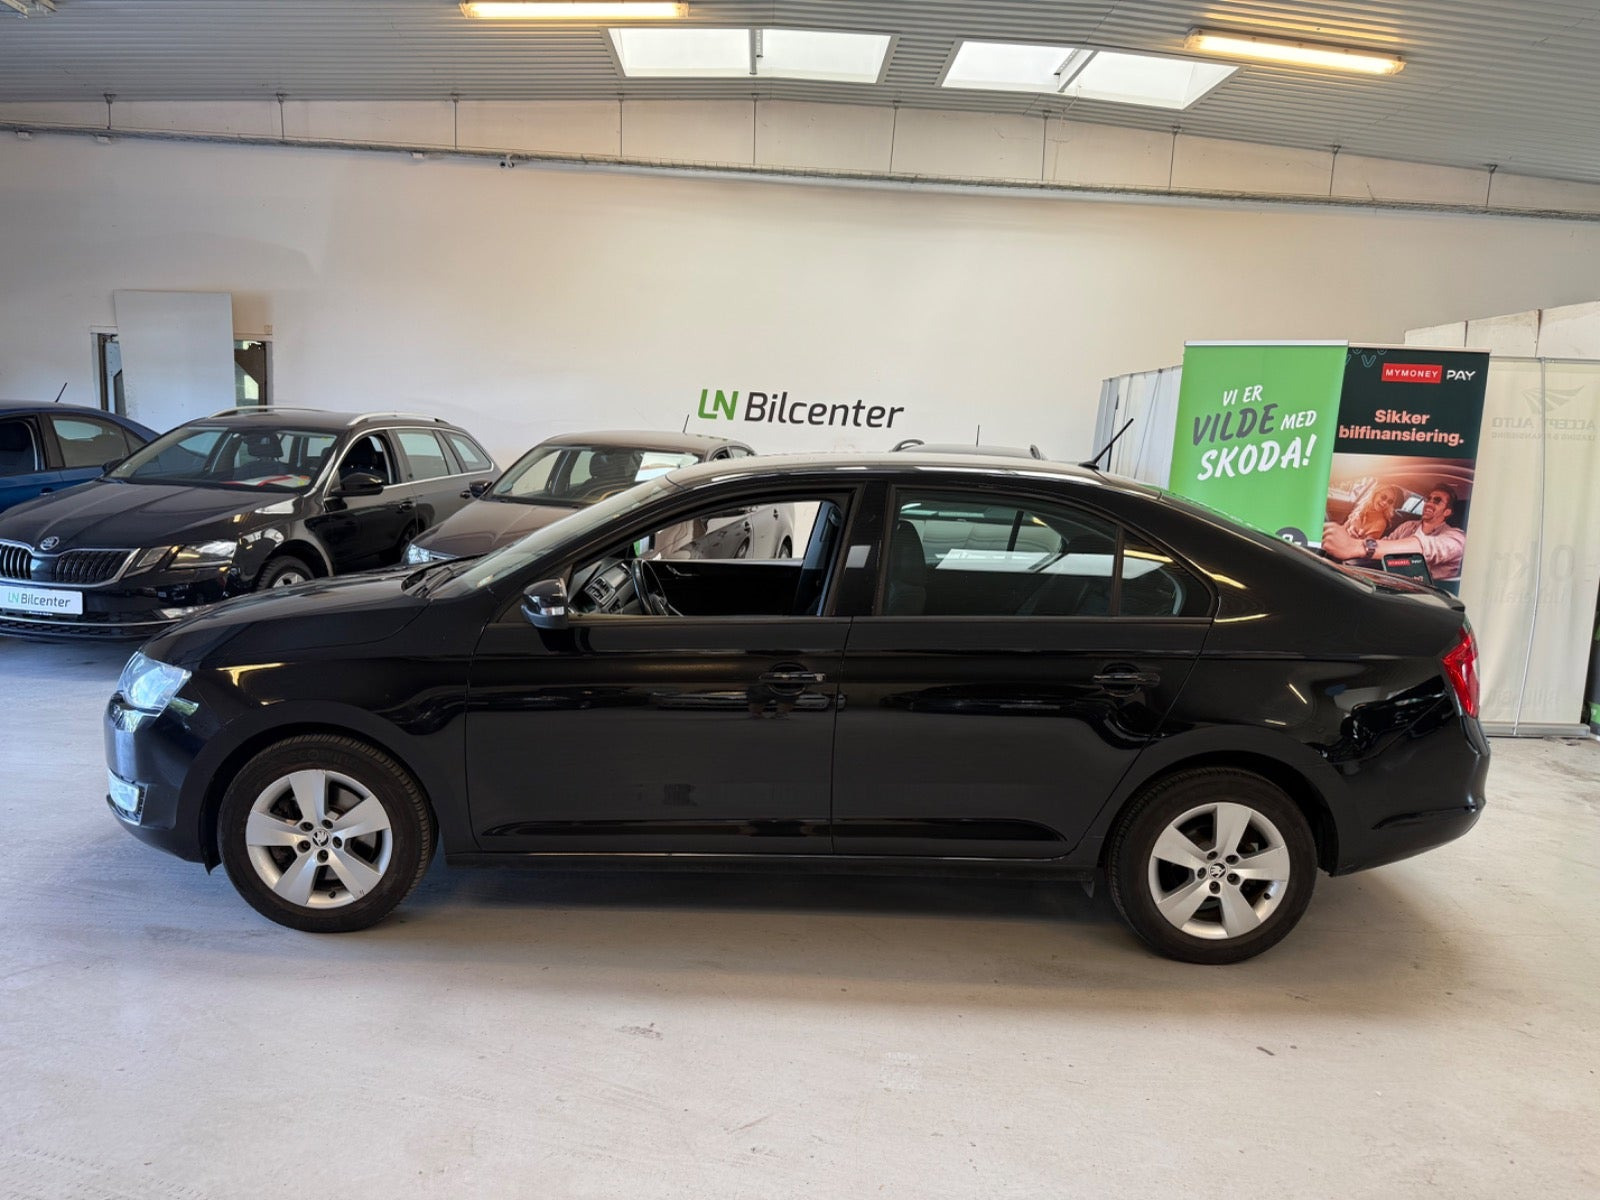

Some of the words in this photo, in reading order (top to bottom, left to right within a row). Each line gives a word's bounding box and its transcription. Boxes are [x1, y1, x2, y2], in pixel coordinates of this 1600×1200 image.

[1385, 368, 1438, 379] MYMONEY
[1446, 370, 1476, 381] PAY
[1222, 388, 1239, 407] VI
[1242, 384, 1264, 403] ER
[697, 388, 739, 421] LN
[743, 391, 905, 428] Bilcenter
[1374, 408, 1431, 425] Sikker
[1192, 402, 1279, 447] VILDE
[1280, 410, 1317, 431] MED
[1337, 425, 1465, 447] bilfinansiering.
[1196, 432, 1318, 481] SKODA!
[8, 591, 19, 603] LN
[20, 592, 71, 608] Bilcenter
